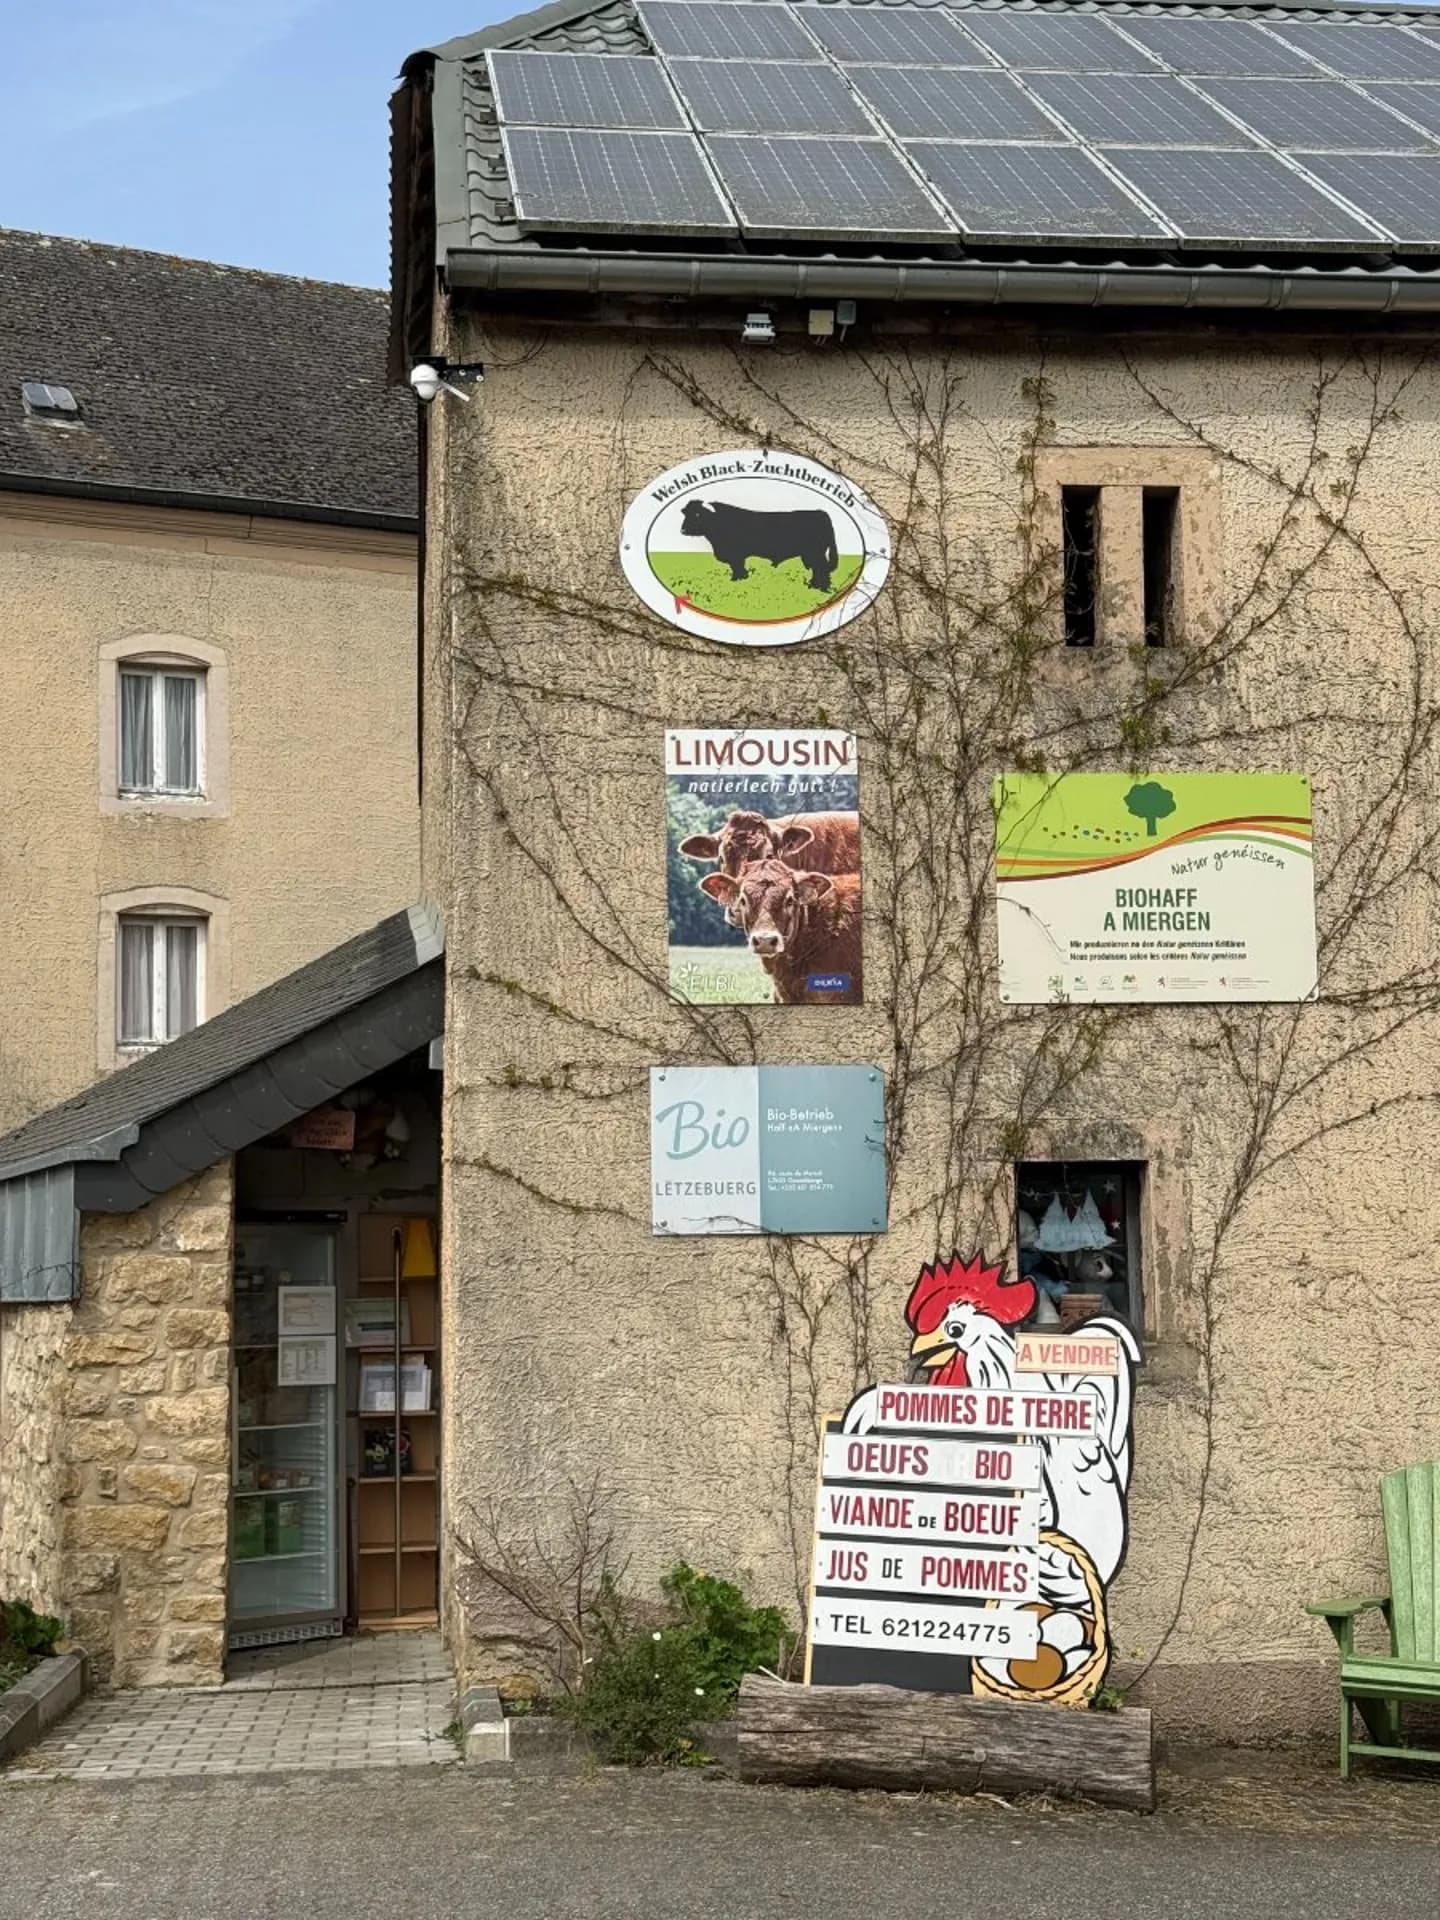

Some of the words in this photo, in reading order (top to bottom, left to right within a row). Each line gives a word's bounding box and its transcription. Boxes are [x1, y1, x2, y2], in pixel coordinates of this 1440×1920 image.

[651, 472, 698, 504] Welsh
[675, 740, 848, 766] LIMOUSIN
[688, 778, 780, 793] natierlech
[1171, 857, 1208, 875] Natur
[1213, 844, 1285, 872] genéissen
[1116, 888, 1198, 908] BIOHAFF
[1104, 912, 1116, 931] A
[1123, 911, 1211, 931] MIERGEN
[768, 1106, 834, 1121] Bio-Betrieb
[655, 1100, 750, 1160] Bio
[1020, 1343, 1033, 1362] A
[1039, 1343, 1116, 1366] VENDRE
[880, 1391, 977, 1425] POMMES
[986, 1396, 1014, 1427] DE
[1022, 1397, 1092, 1431] TERRE
[847, 1441, 929, 1476] OEUFS
[975, 1449, 1012, 1480] BIO
[829, 1494, 914, 1529] VIANDE
[918, 1515, 937, 1529] DE
[944, 1501, 1021, 1536] BOEUF
[826, 1550, 868, 1581] JUS
[881, 1557, 903, 1580] DE
[921, 1556, 1028, 1592] POMMES
[830, 1614, 872, 1635] TEL
[882, 1618, 1011, 1645] 621224775
